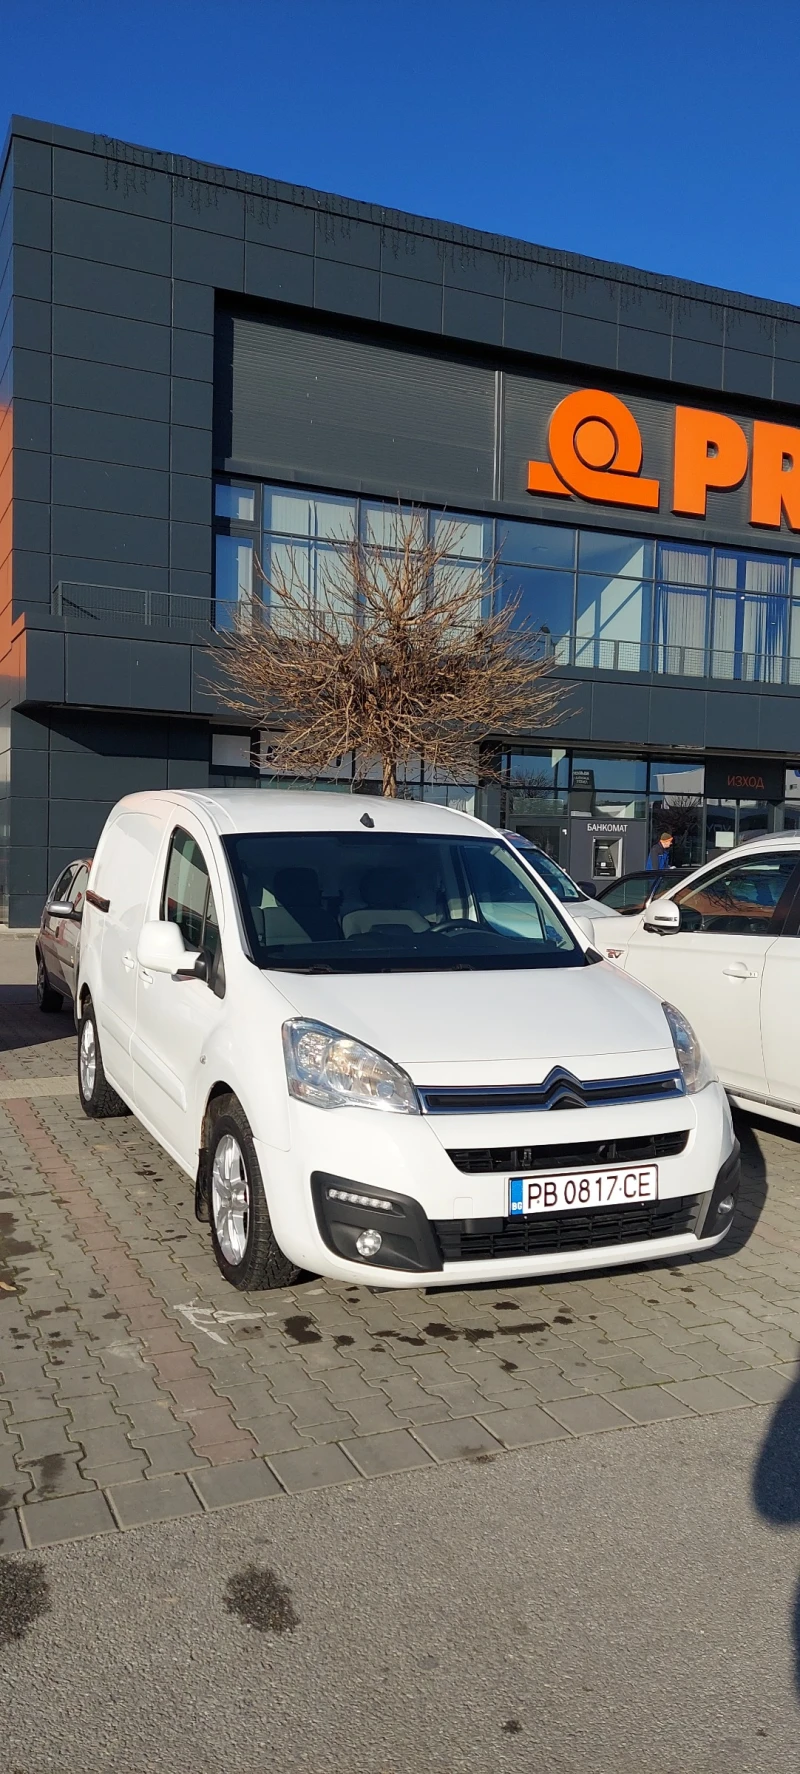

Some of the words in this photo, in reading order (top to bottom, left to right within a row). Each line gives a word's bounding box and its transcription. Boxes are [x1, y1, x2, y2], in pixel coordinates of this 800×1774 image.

[727, 775, 765, 790] ИЗХОД
[587, 823, 628, 833] БАНКОМАТ
[528, 1181, 558, 1210] PB
[563, 1175, 619, 1205] 0817
[623, 1172, 651, 1199] CE
[511, 1202, 523, 1211] BG
